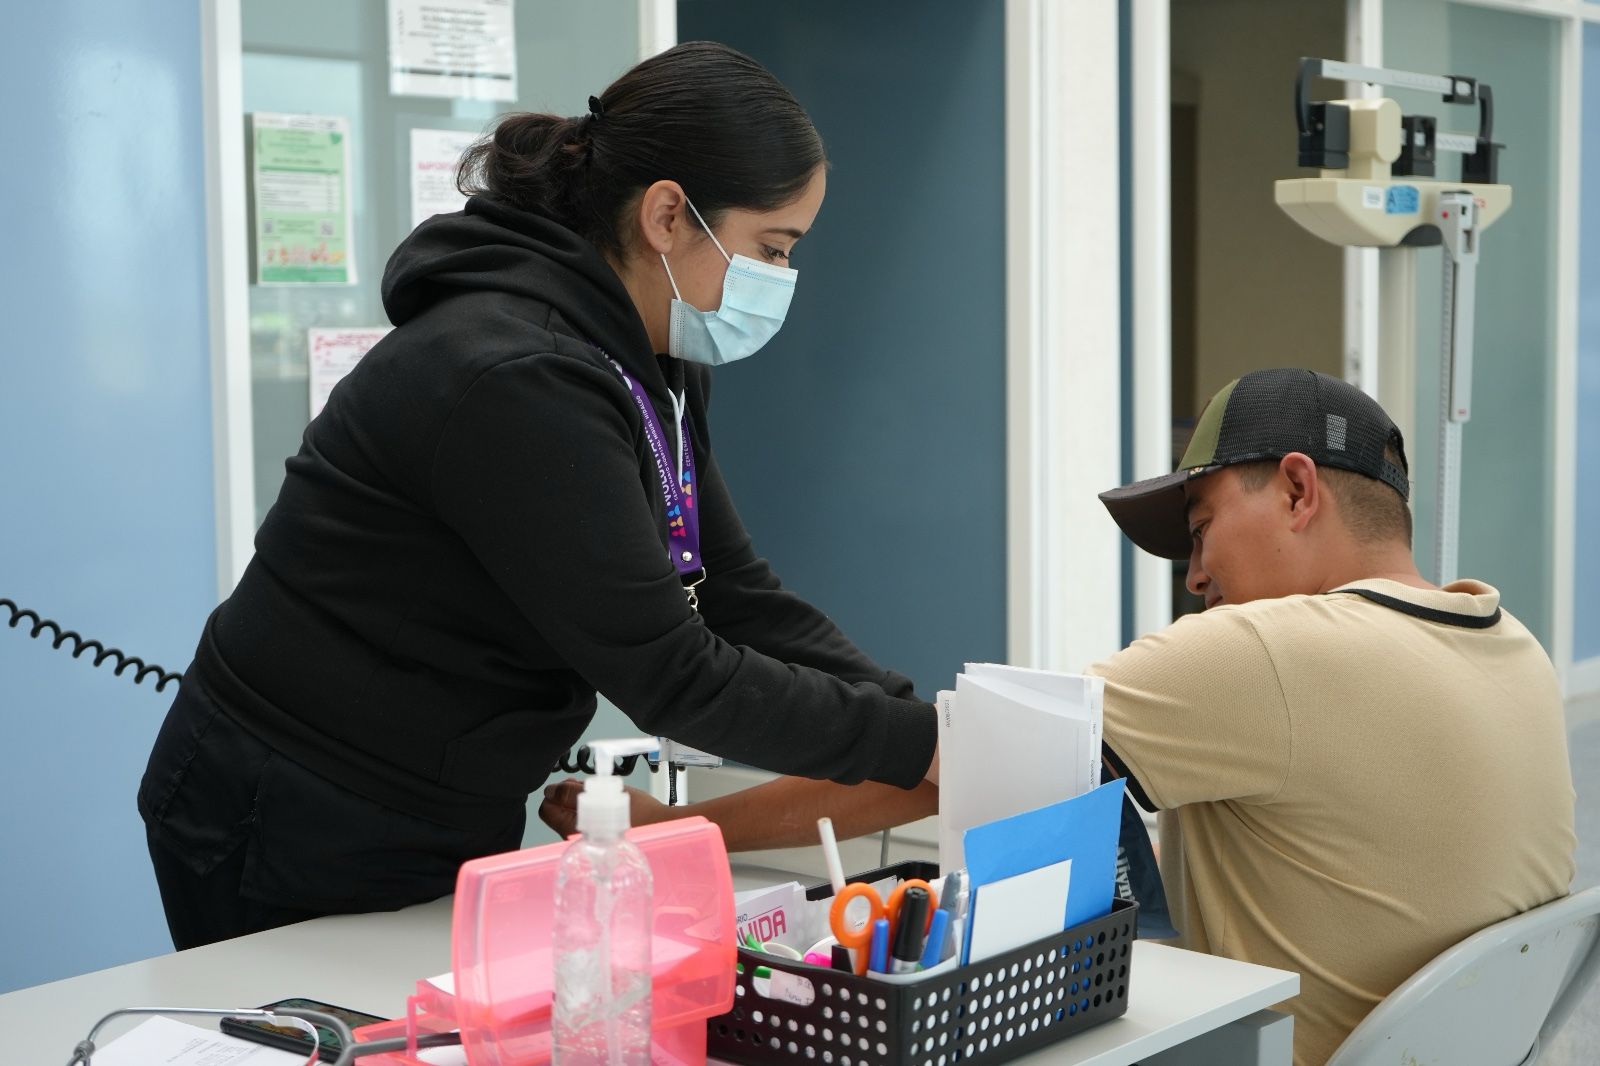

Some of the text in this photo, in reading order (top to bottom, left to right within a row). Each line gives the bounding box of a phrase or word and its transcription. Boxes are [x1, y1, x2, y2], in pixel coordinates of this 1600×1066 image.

[636, 395, 678, 501] CENTENARIO HOSPITAL MIGUEL HIDALGO
